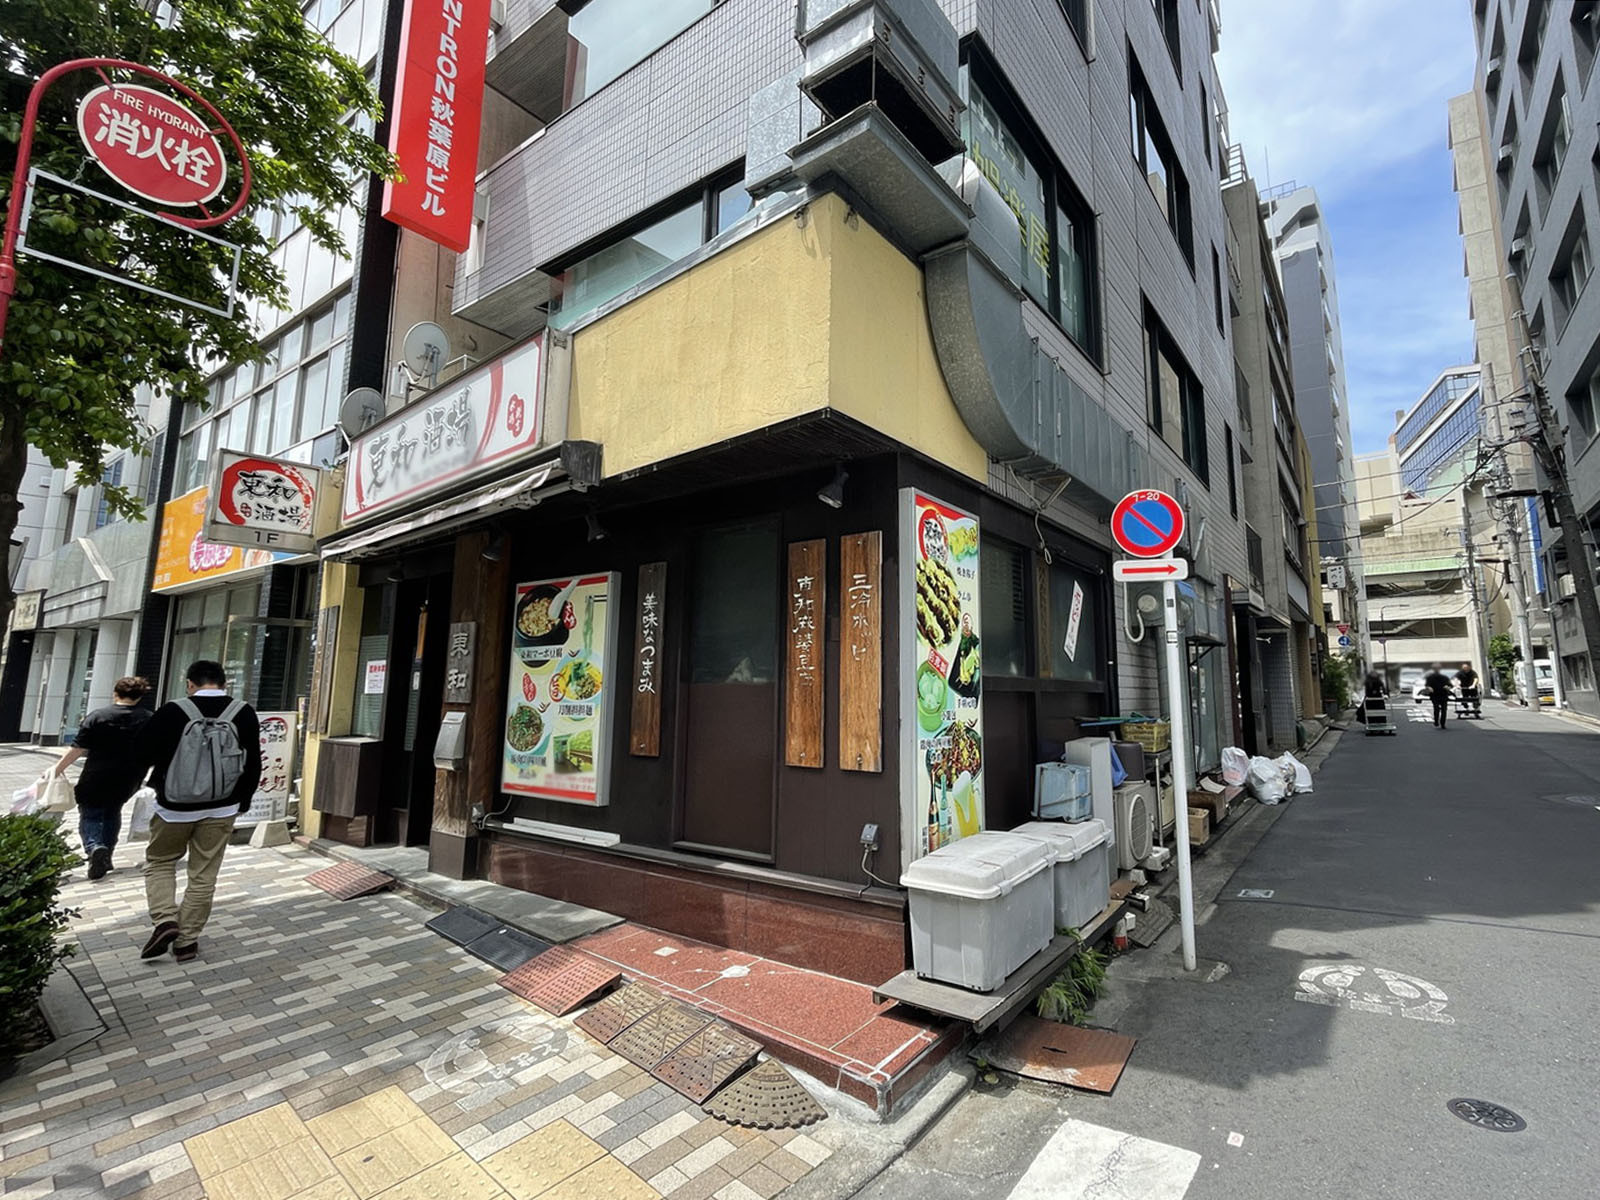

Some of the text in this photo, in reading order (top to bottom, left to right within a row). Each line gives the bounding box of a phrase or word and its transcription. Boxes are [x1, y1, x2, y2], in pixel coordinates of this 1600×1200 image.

[113, 89, 206, 139] FIRE HYDRANT
[94, 103, 215, 188] 消火栓
[239, 471, 298, 500] 東和
[254, 531, 280, 544] 1F
[255, 503, 301, 526] 酒場
[448, 632, 469, 689] 東和
[638, 592, 658, 694] 美味なつまみ
